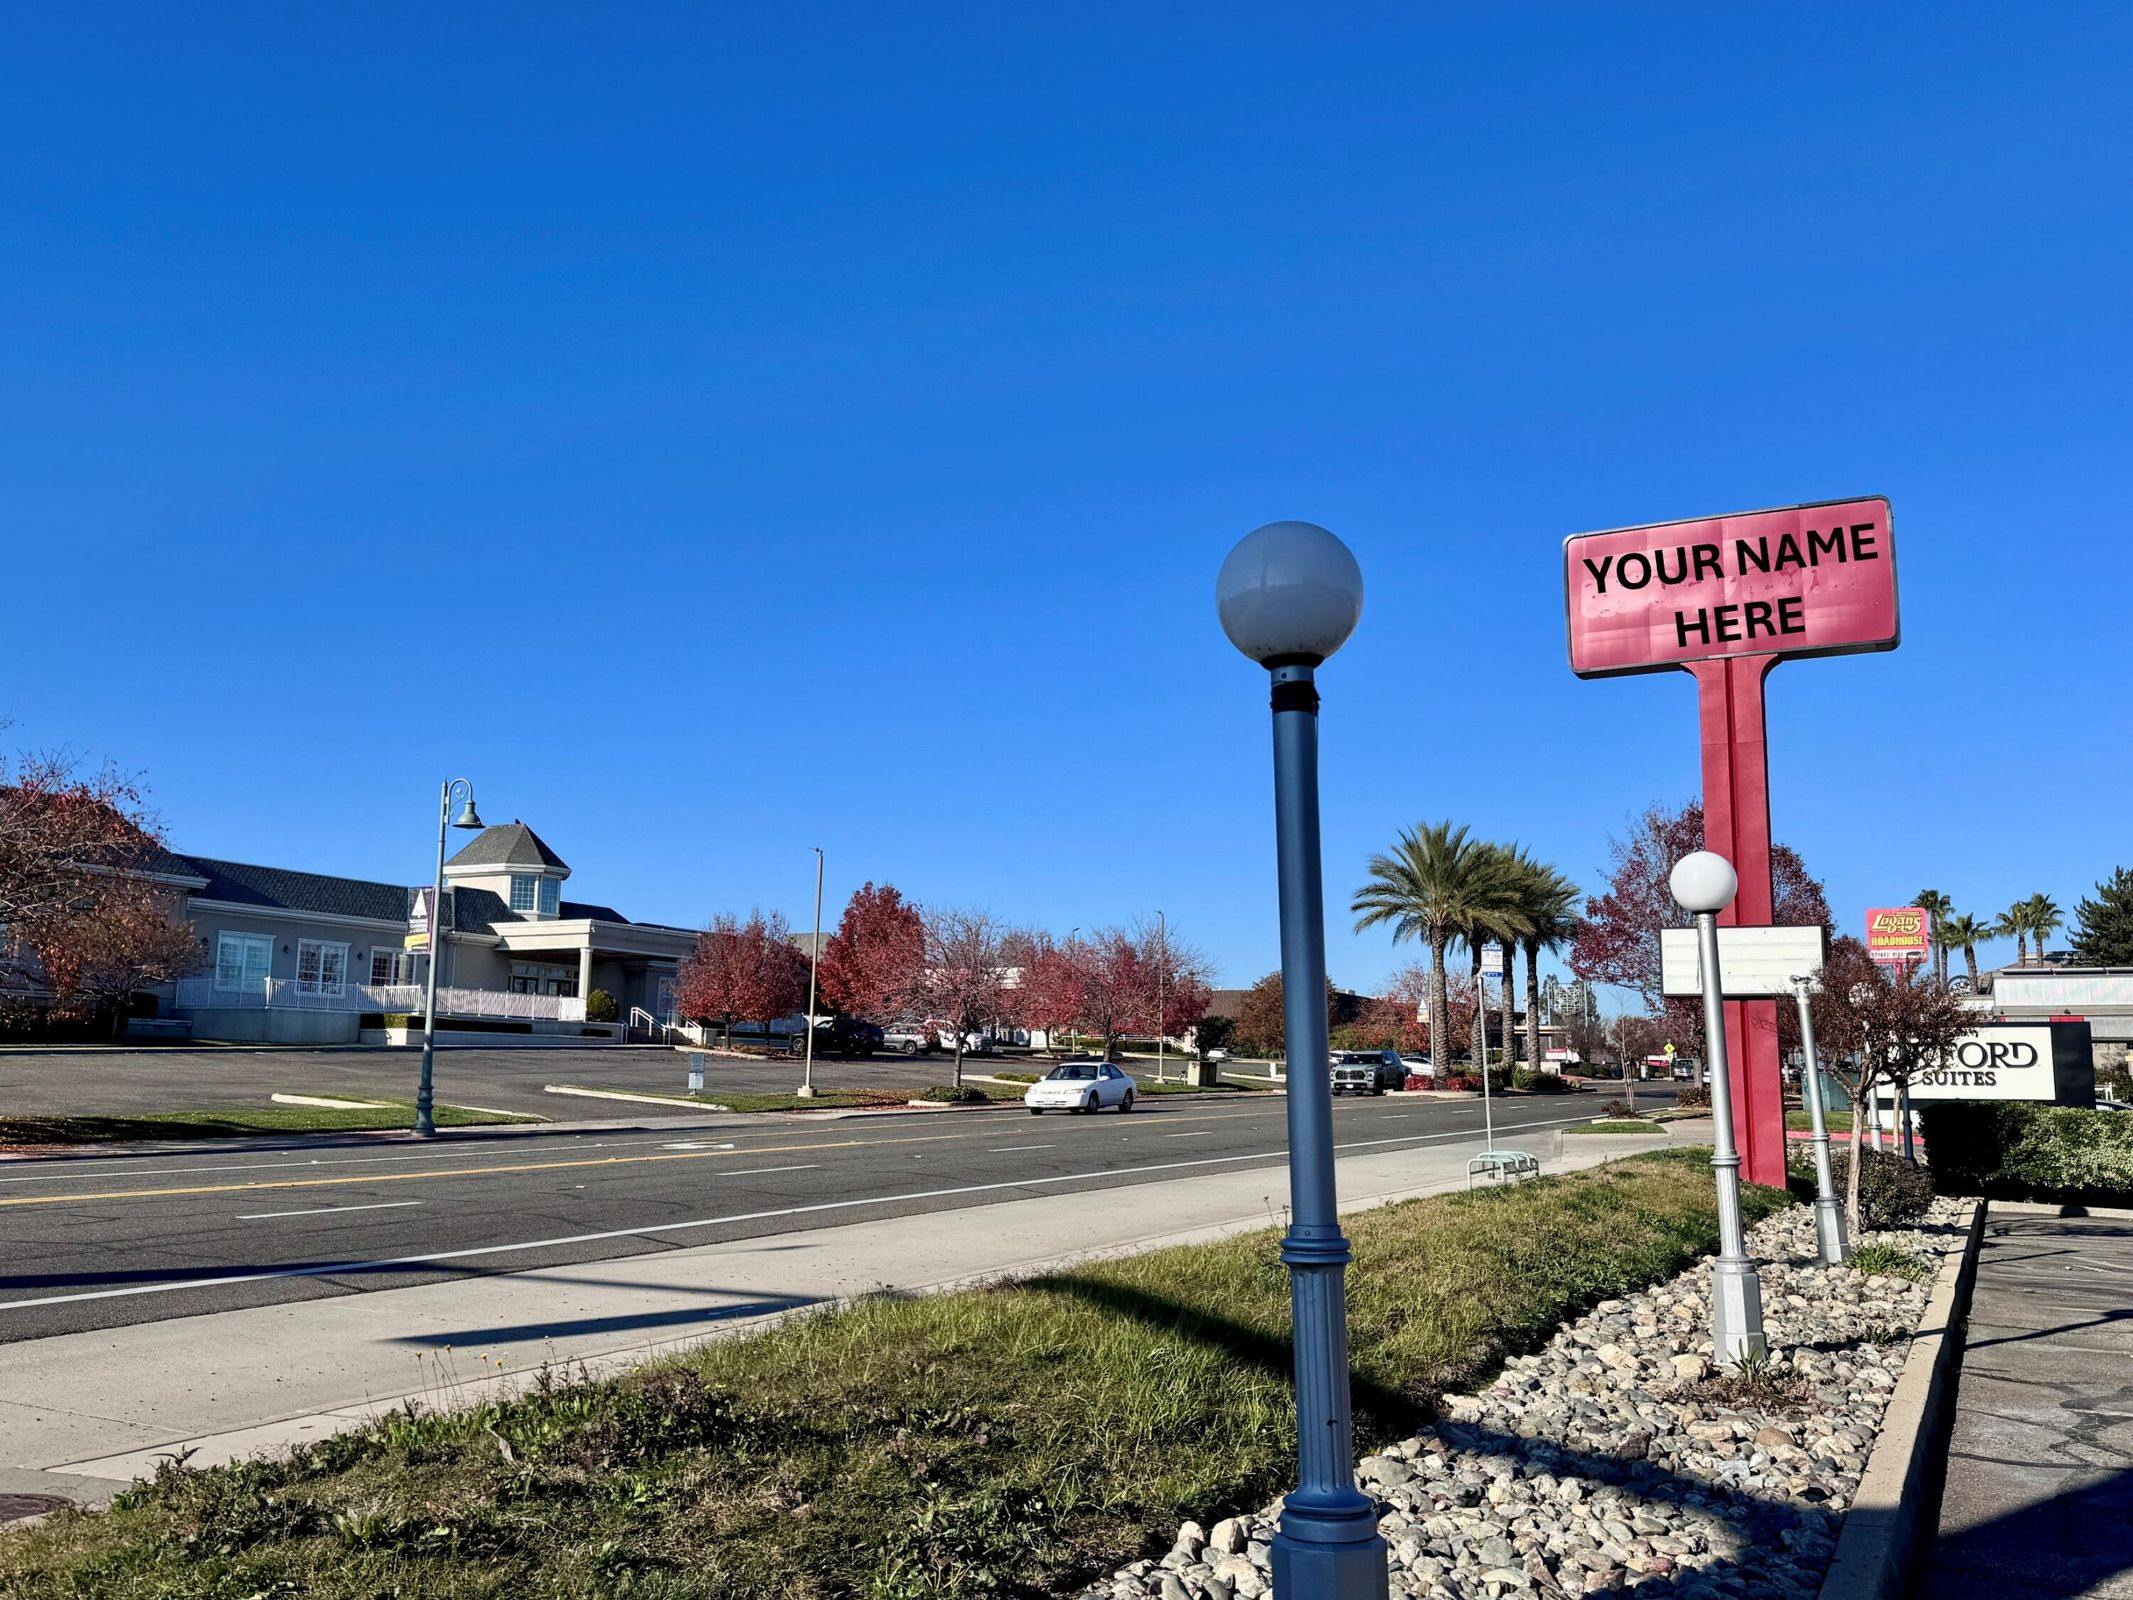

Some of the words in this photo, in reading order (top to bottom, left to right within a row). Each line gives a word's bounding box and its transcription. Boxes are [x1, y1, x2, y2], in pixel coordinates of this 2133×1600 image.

[1583, 544, 1724, 594] YOUR
[1736, 523, 1878, 575] NAME
[1675, 596, 1806, 647] HERE
[1871, 936, 1923, 947] ROADHOUSE
[1915, 1041, 2038, 1069] FORD
[1922, 1071, 1997, 1086] SUITES
